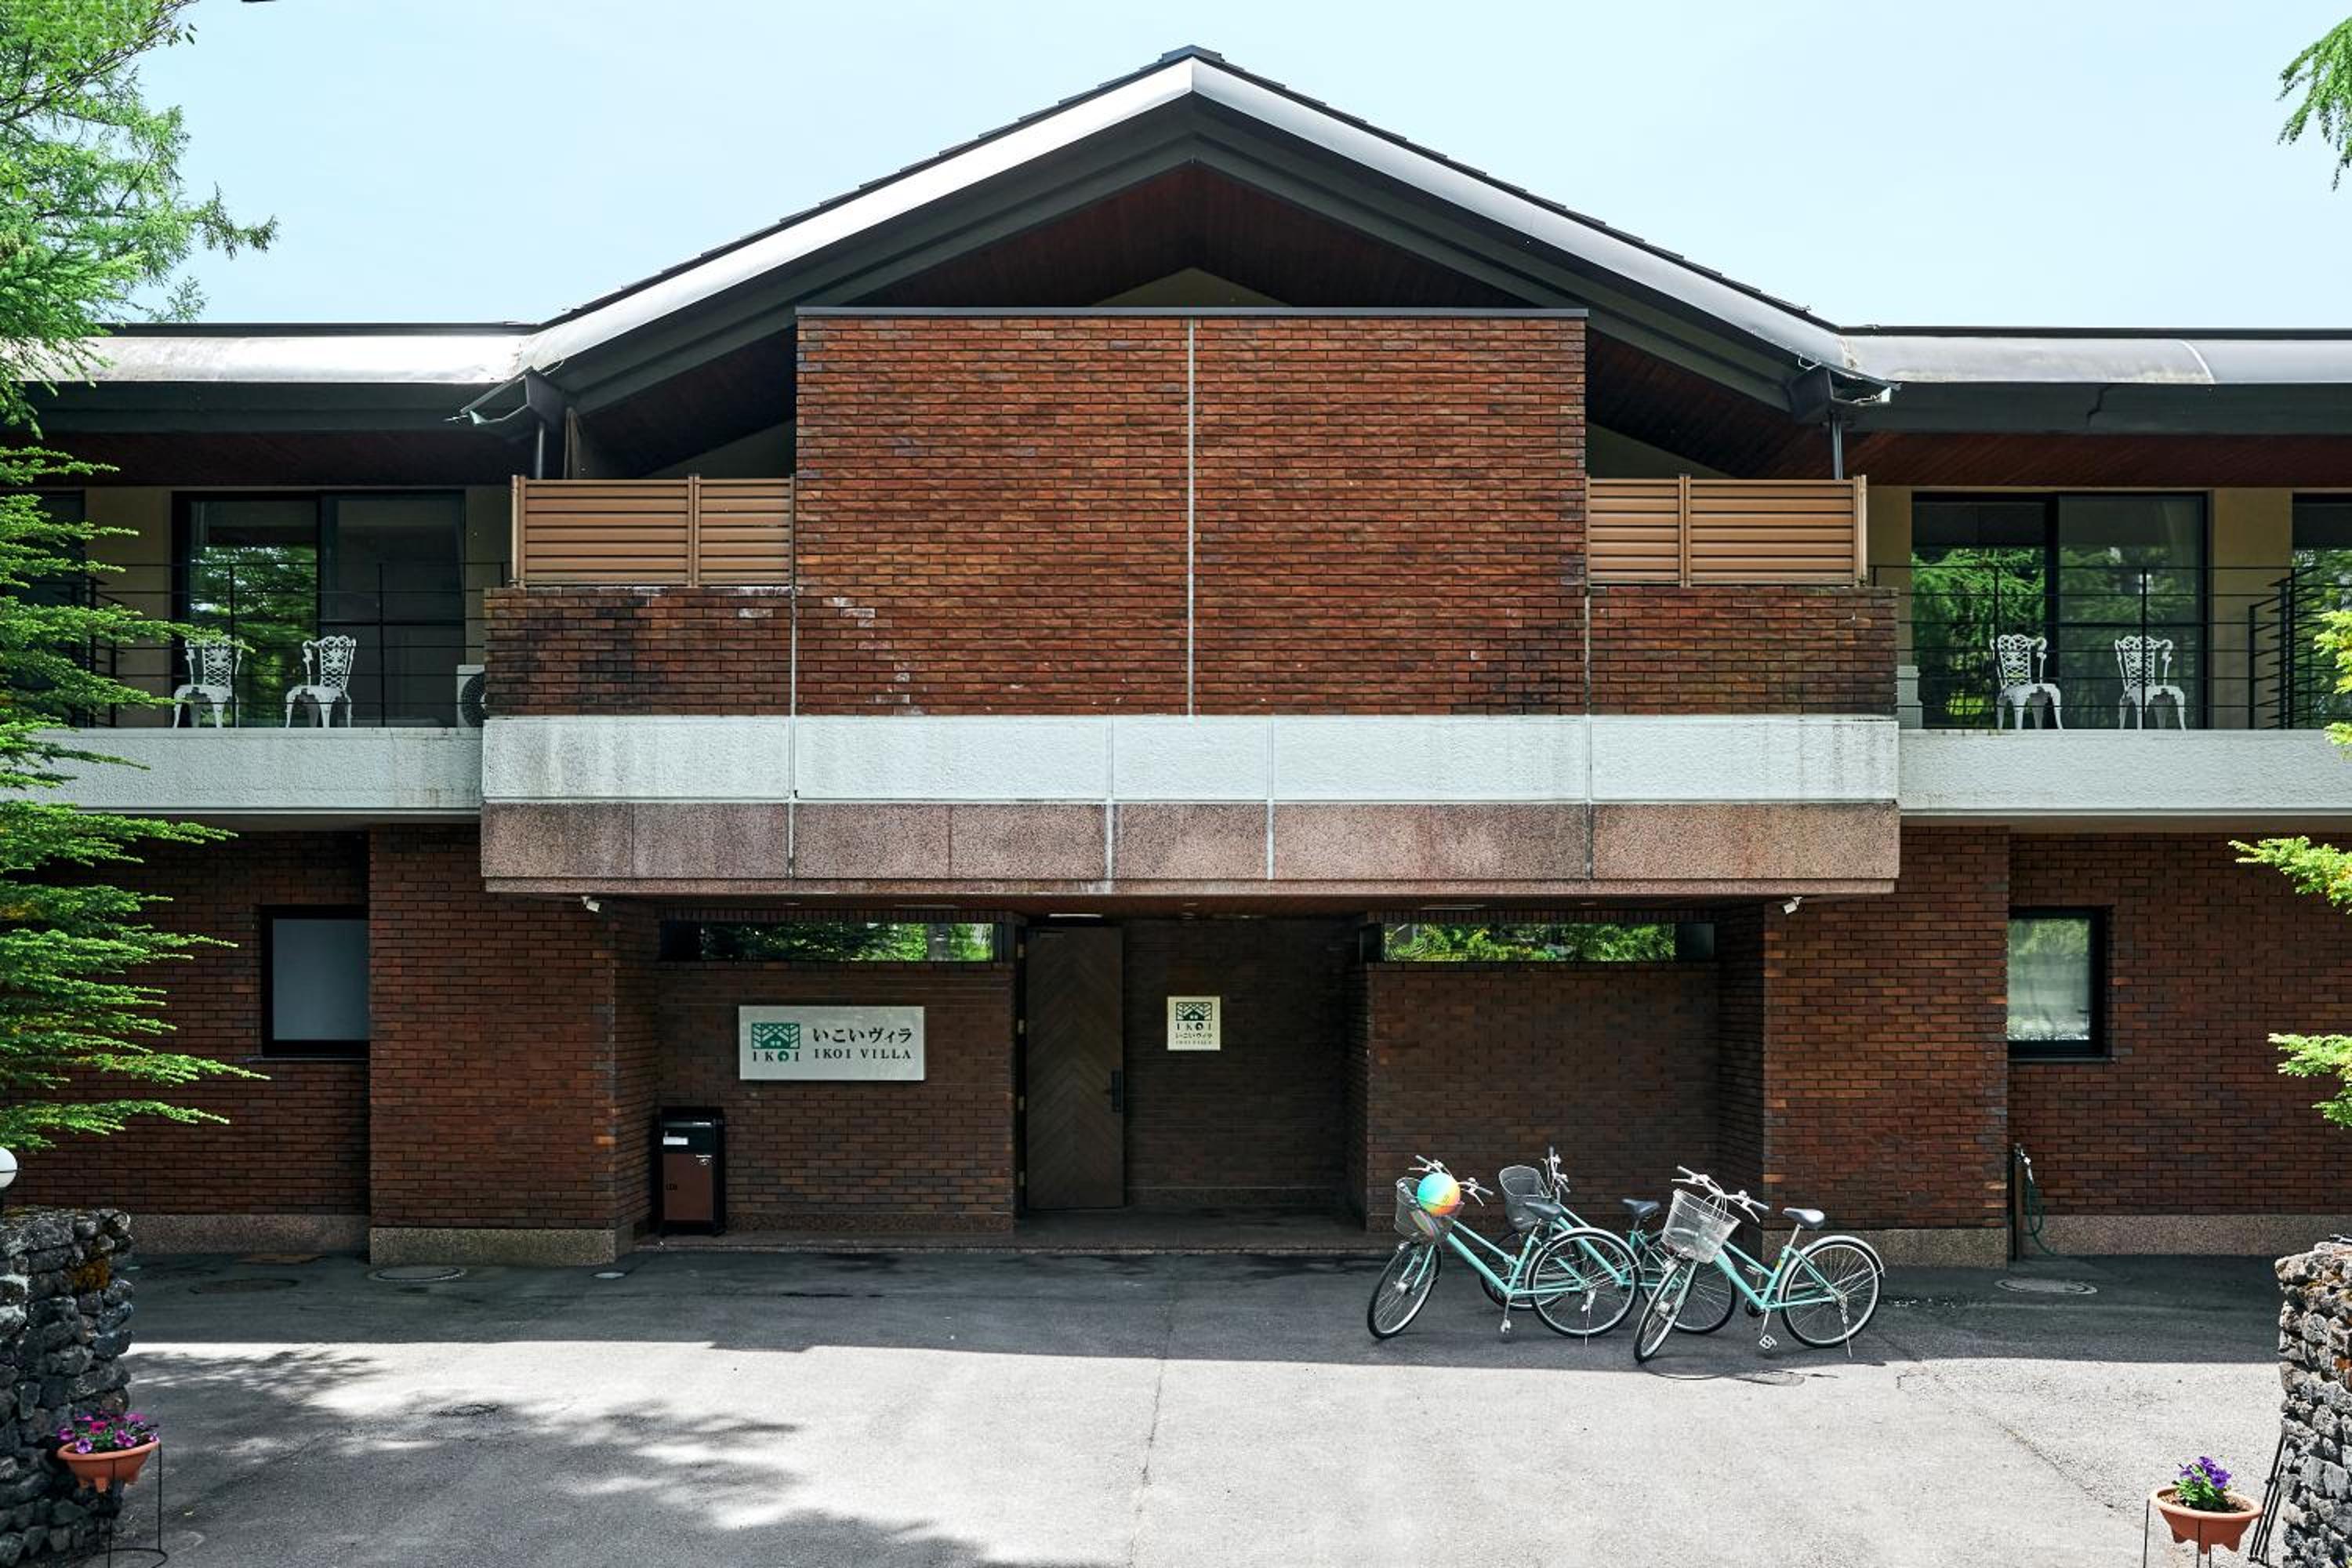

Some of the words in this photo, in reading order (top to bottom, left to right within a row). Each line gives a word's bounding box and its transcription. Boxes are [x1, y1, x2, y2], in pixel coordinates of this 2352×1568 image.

[1177, 1022, 1211, 1031] IKOI
[814, 1028, 912, 1044] いこいヴィラ
[753, 1051, 799, 1062] IKOI
[815, 1049, 851, 1059] IKOI
[861, 1049, 911, 1059] VILLA
